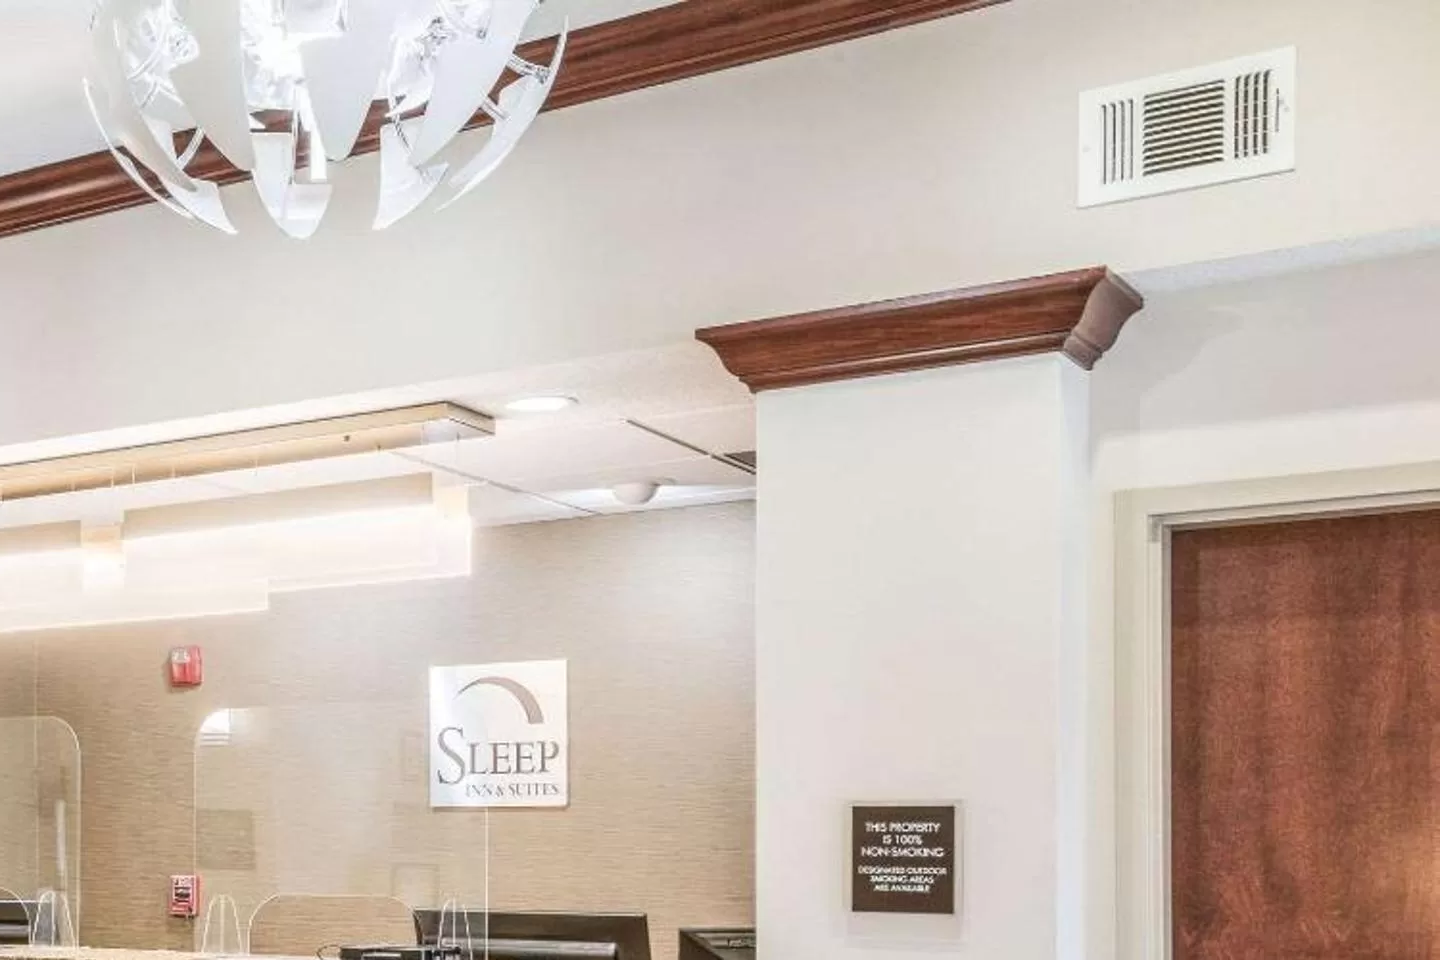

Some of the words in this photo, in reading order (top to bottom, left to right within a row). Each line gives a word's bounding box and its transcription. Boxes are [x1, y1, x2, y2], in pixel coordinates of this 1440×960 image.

[437, 726, 560, 785] SLEEP
[508, 782, 560, 797] SUITES
[865, 822, 888, 833] THIS
[889, 822, 941, 833] PROPERTY
[882, 835, 892, 845] IS
[895, 835, 923, 846] 100%
[860, 846, 945, 858] NON-SMOKING
